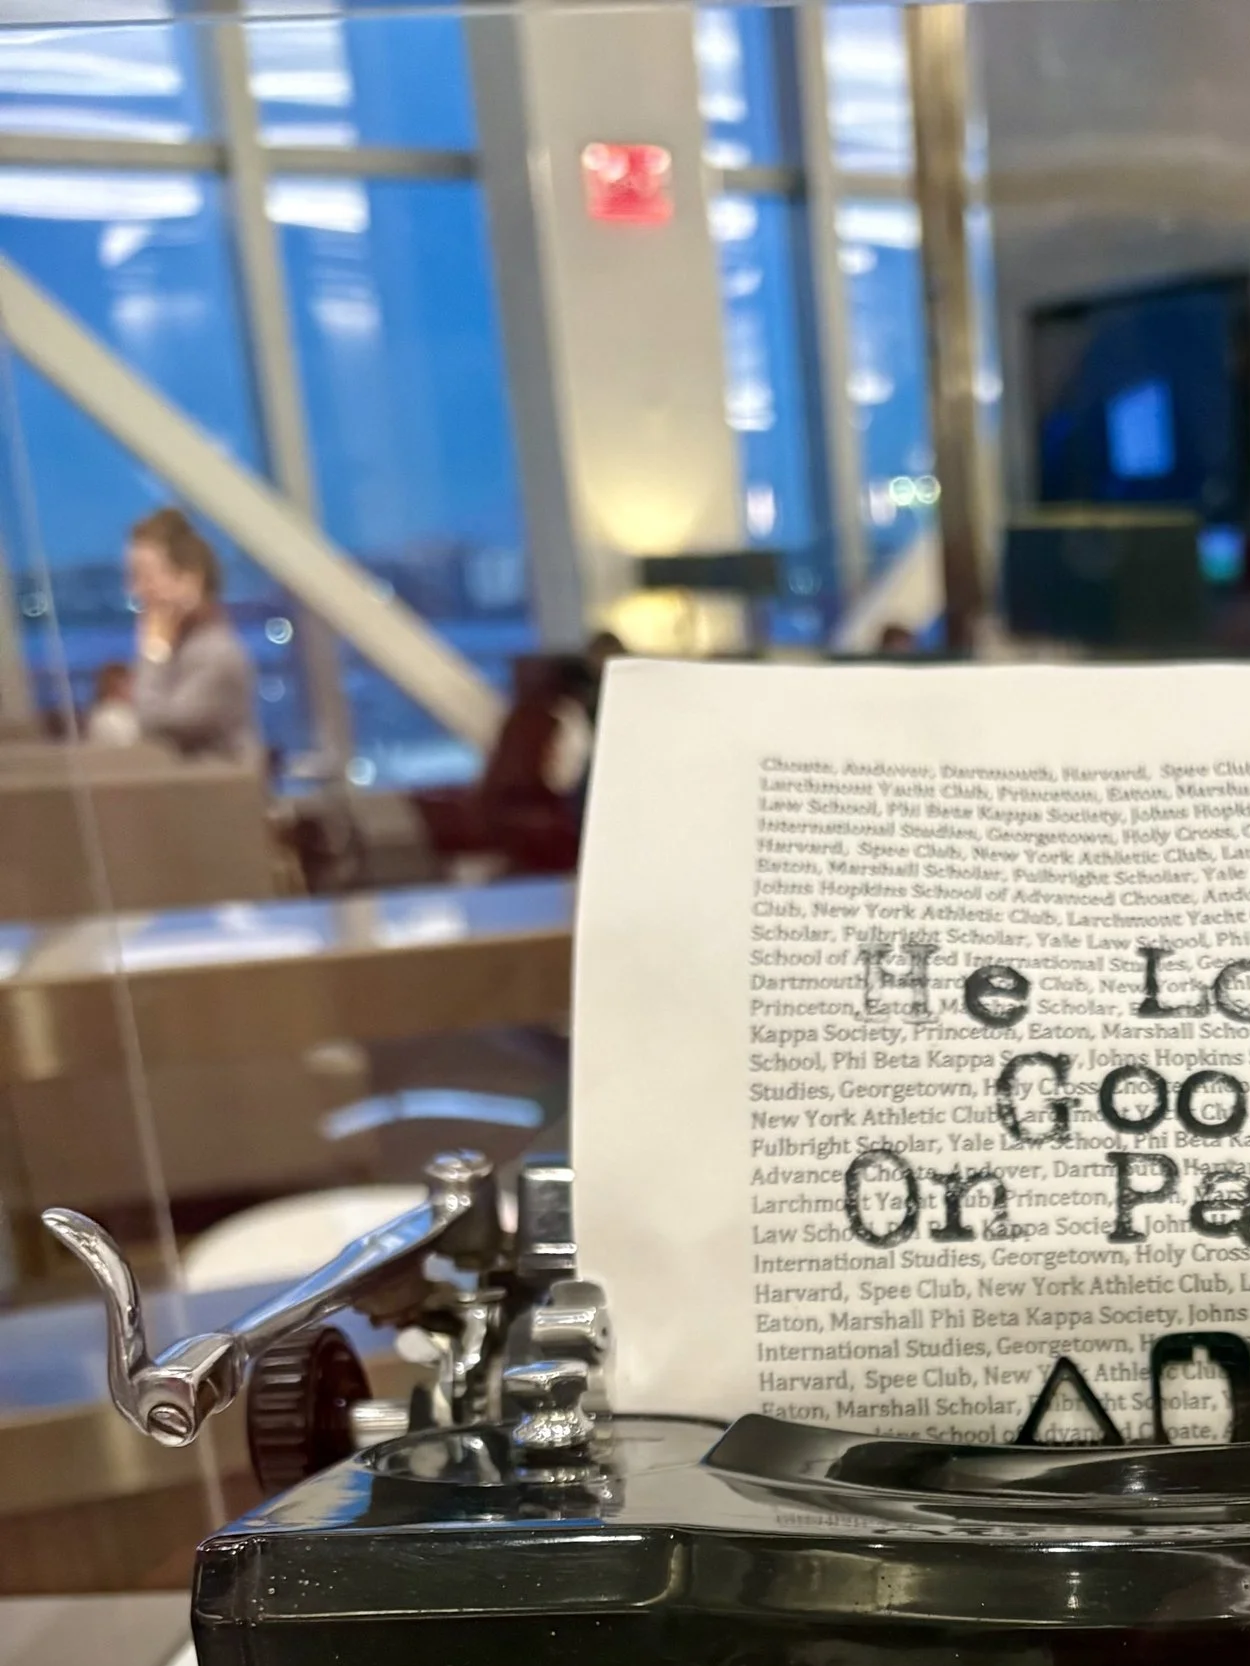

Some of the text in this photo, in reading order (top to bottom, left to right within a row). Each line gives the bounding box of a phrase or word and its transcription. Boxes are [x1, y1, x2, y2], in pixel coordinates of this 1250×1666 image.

[750, 1025, 816, 1046] Kappa
[822, 1025, 906, 1045] Society,
[912, 1024, 1023, 1043] Princeton,
[1028, 1022, 1096, 1041] Eaton,
[1102, 1022, 1194, 1039] Marshall
[750, 1051, 827, 1072] School,
[832, 1051, 866, 1069] Phi
[872, 1051, 921, 1069] Beta
[927, 1050, 994, 1072] Kappa
[1087, 1049, 1148, 1070] Johns
[1155, 1048, 1244, 1070] Hopkins
[845, 1148, 1028, 1250] On
[754, 1253, 895, 1273] International
[900, 1250, 987, 1270] Studies,
[991, 1248, 1130, 1270] Georgetown,
[1137, 1245, 1185, 1267] Holy
[755, 1282, 850, 1304] Harvard,
[860, 1281, 912, 1305] Spee
[917, 1279, 972, 1300] Club,
[979, 1278, 1026, 1297] New
[1032, 1276, 1084, 1296] York
[1090, 1275, 1174, 1296] Athletic
[1179, 1274, 1235, 1295] Club,
[756, 1314, 824, 1334] Eaton,
[830, 1309, 924, 1331] Marshall
[931, 1309, 965, 1328] Phi
[972, 1308, 1020, 1328] Beta
[1026, 1307, 1093, 1329] Kappa
[1099, 1305, 1184, 1328] Society,
[1188, 1303, 1248, 1324] Johns
[760, 1366, 1032, 1392] Harvard, Spee Club, New
